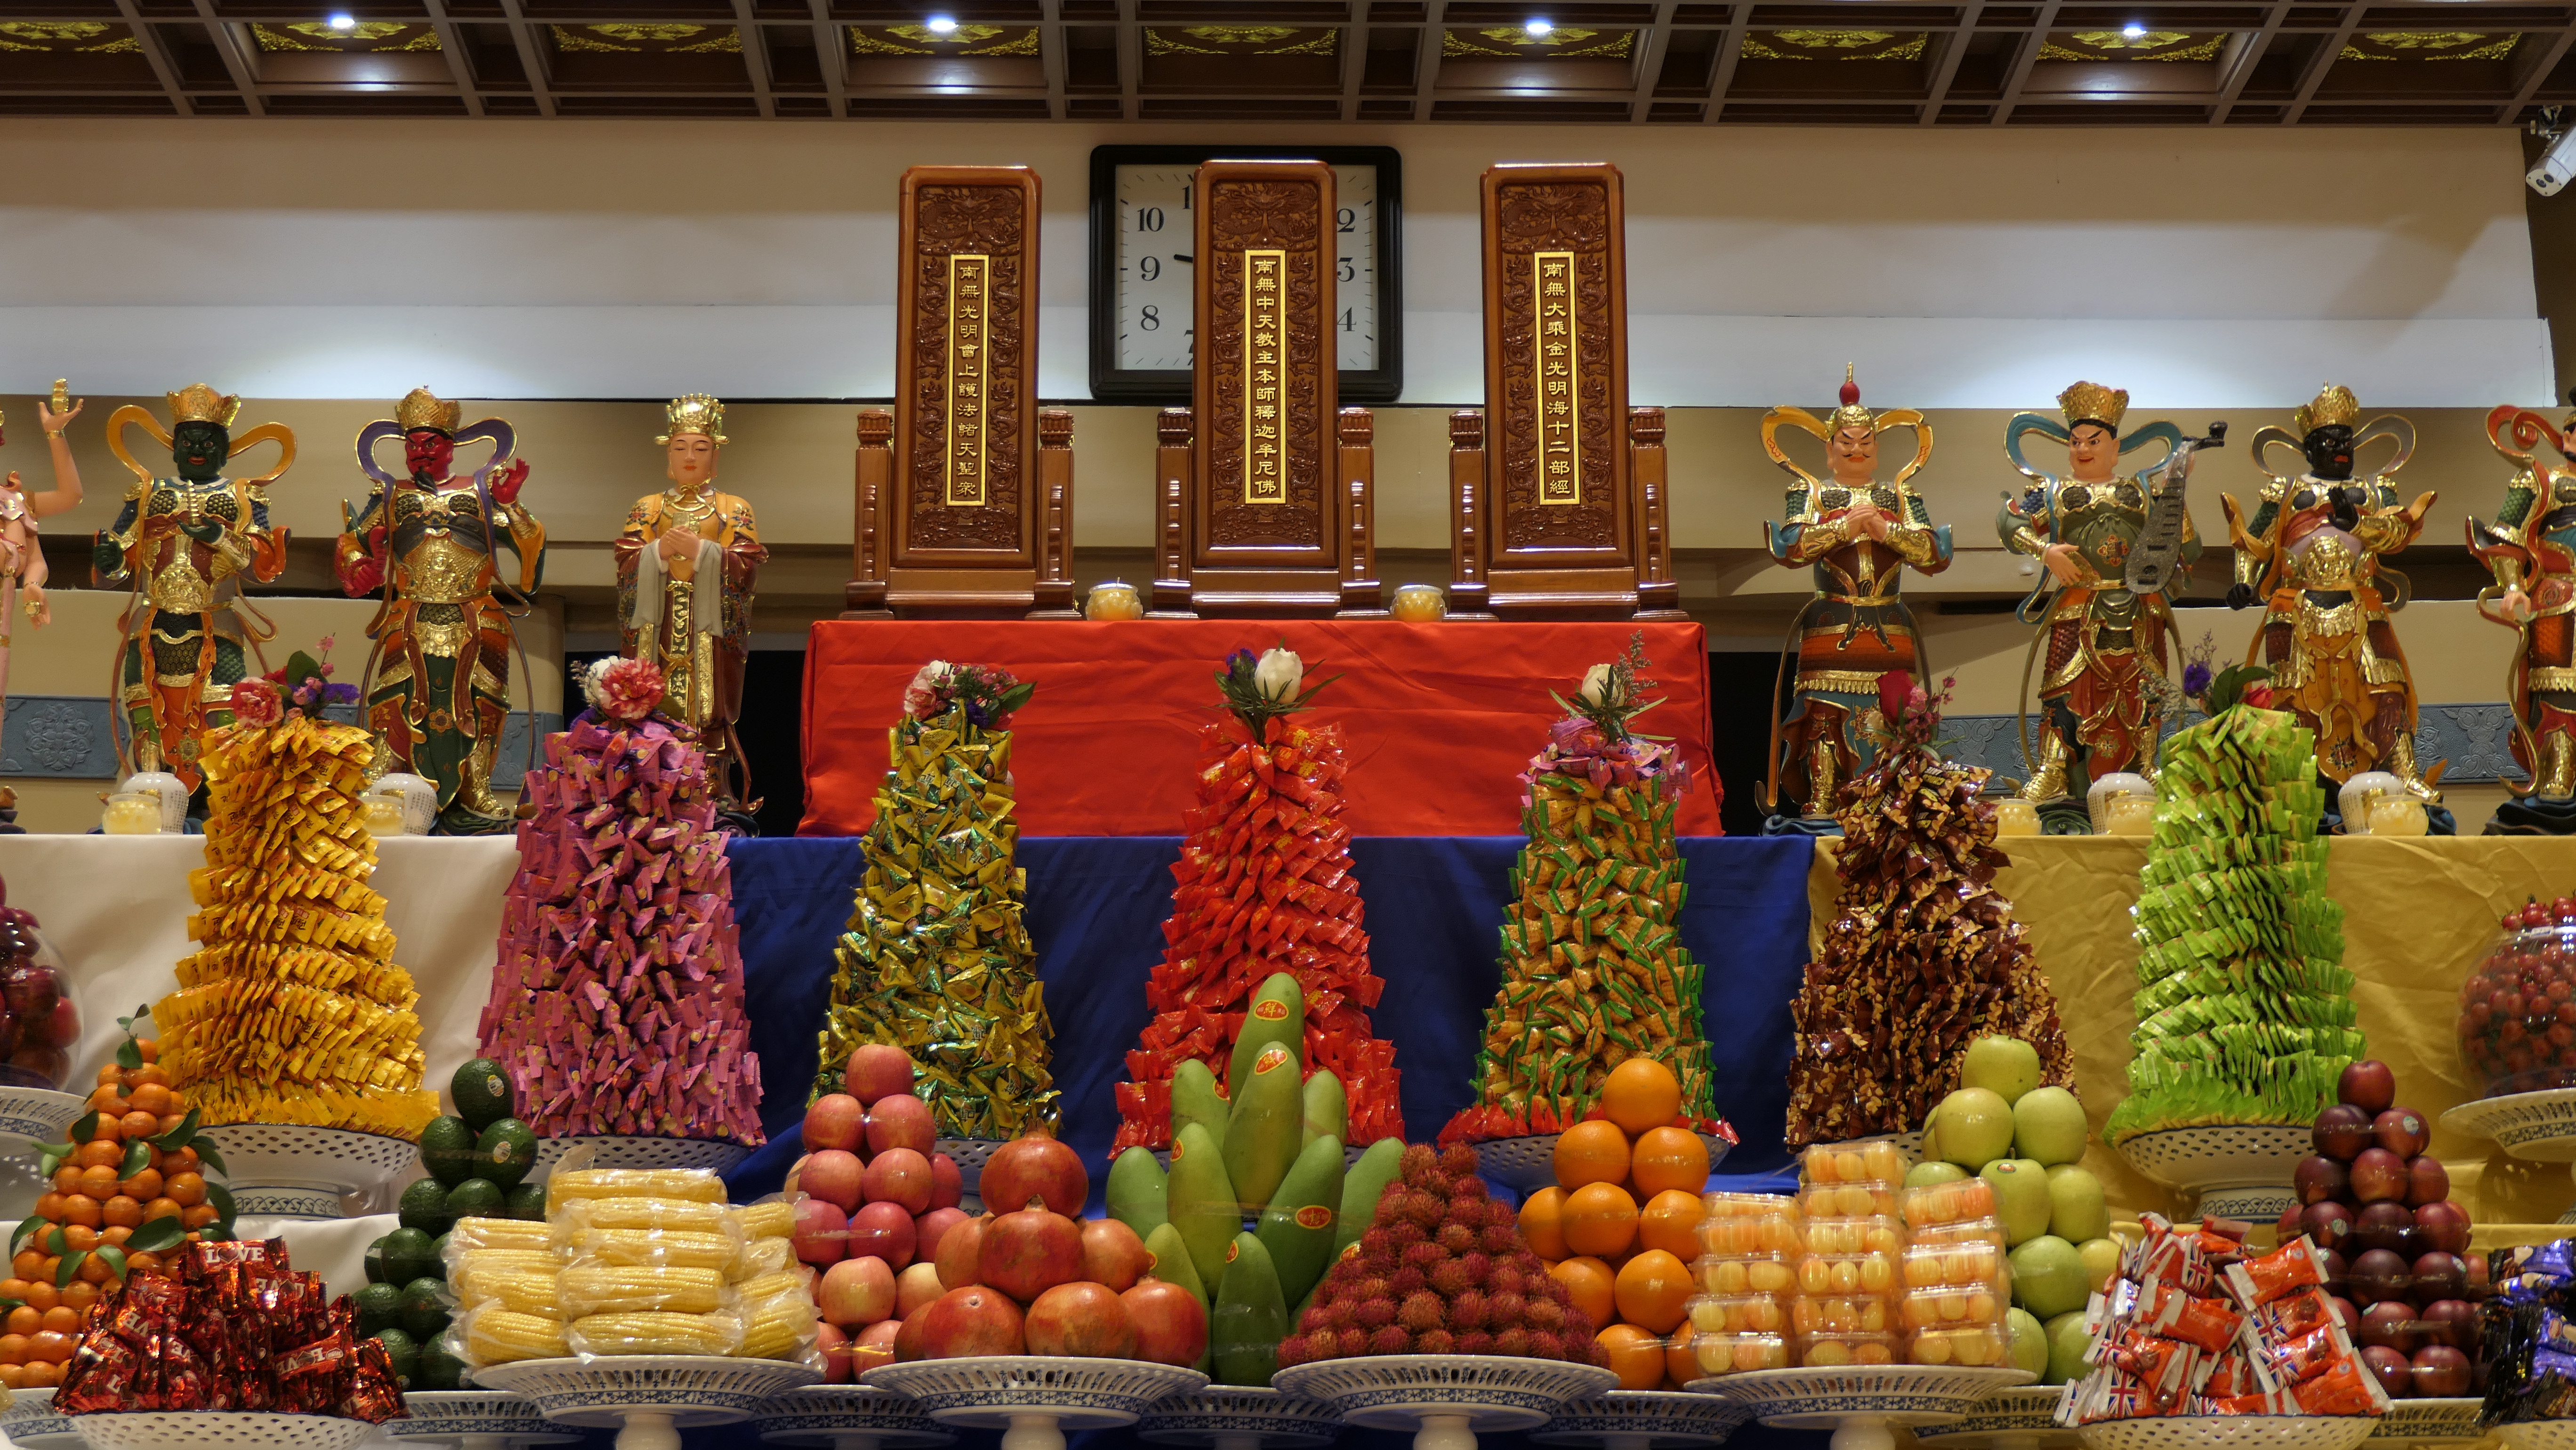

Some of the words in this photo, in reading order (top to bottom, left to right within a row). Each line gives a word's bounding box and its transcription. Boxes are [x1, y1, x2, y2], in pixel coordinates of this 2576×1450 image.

[1138, 207, 1165, 232] 10
[1337, 208, 1356, 233] 2
[1141, 256, 1161, 282] 9
[1337, 257, 1355, 282] 3
[1140, 305, 1160, 331] 8
[1337, 306, 1357, 332] 4
[1254, 260, 1277, 494] 南無中天教主本師釋迦牟尼佛
[1544, 263, 1570, 495] 南無大乘金光明海十二部經
